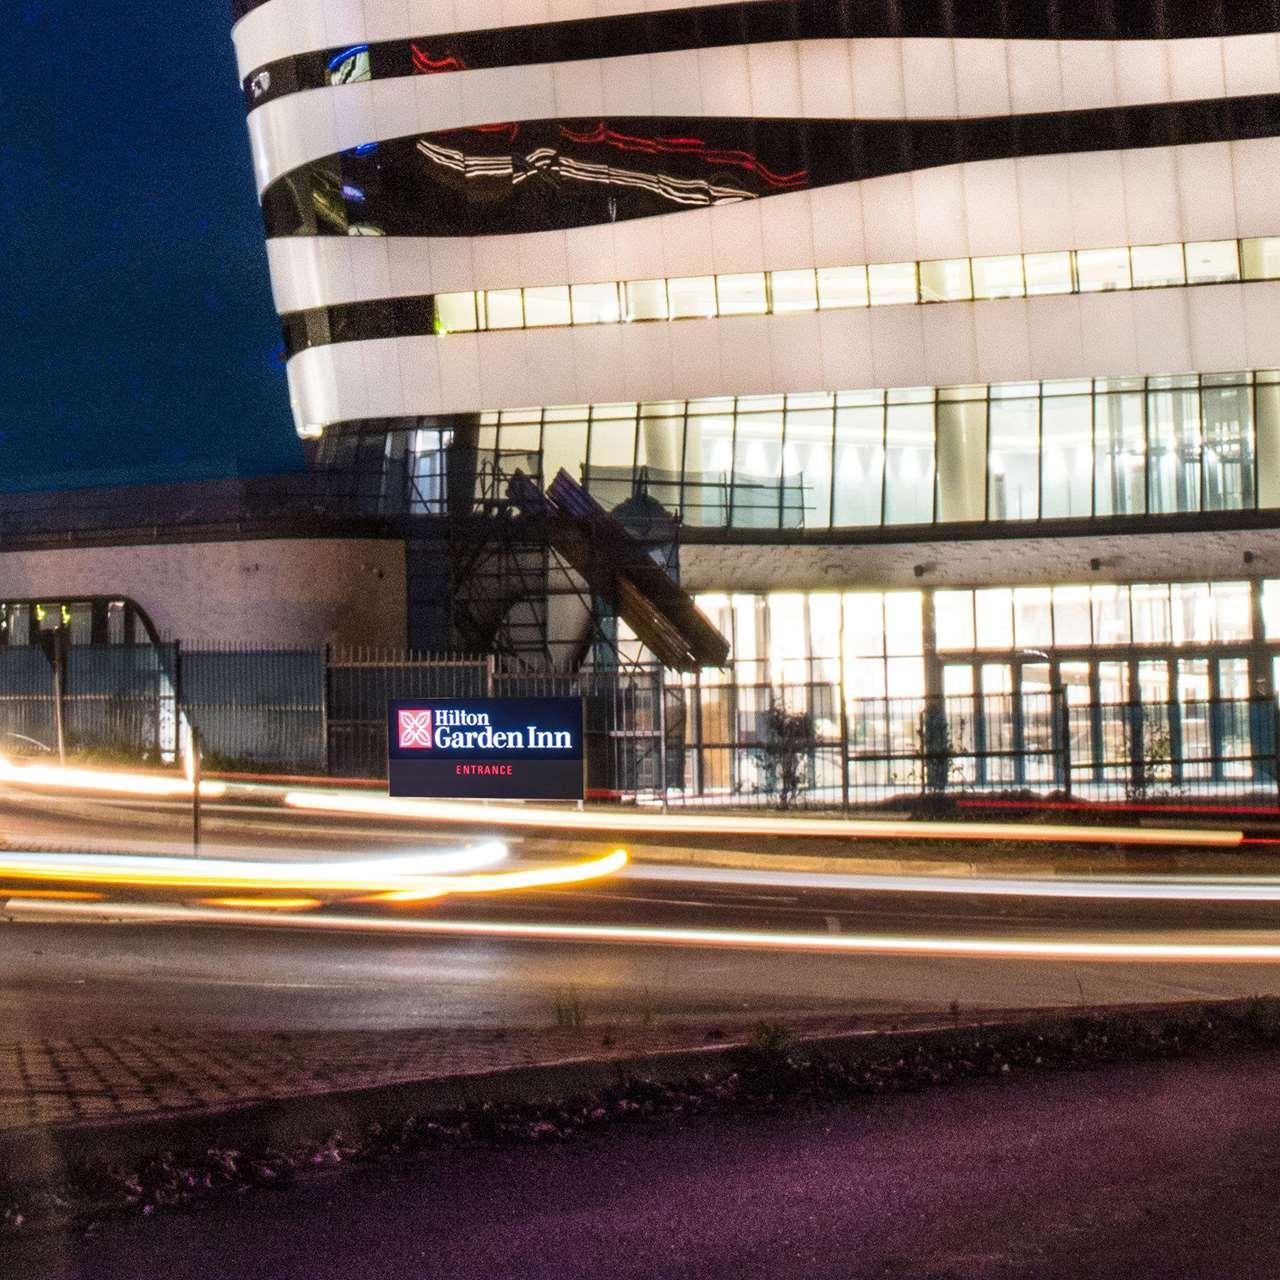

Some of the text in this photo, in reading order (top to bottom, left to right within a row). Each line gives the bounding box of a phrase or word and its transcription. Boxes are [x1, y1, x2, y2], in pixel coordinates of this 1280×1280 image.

[434, 709, 490, 726] Hilton
[434, 726, 572, 749] Garden Inn
[455, 765, 513, 775] ENTRANCE
